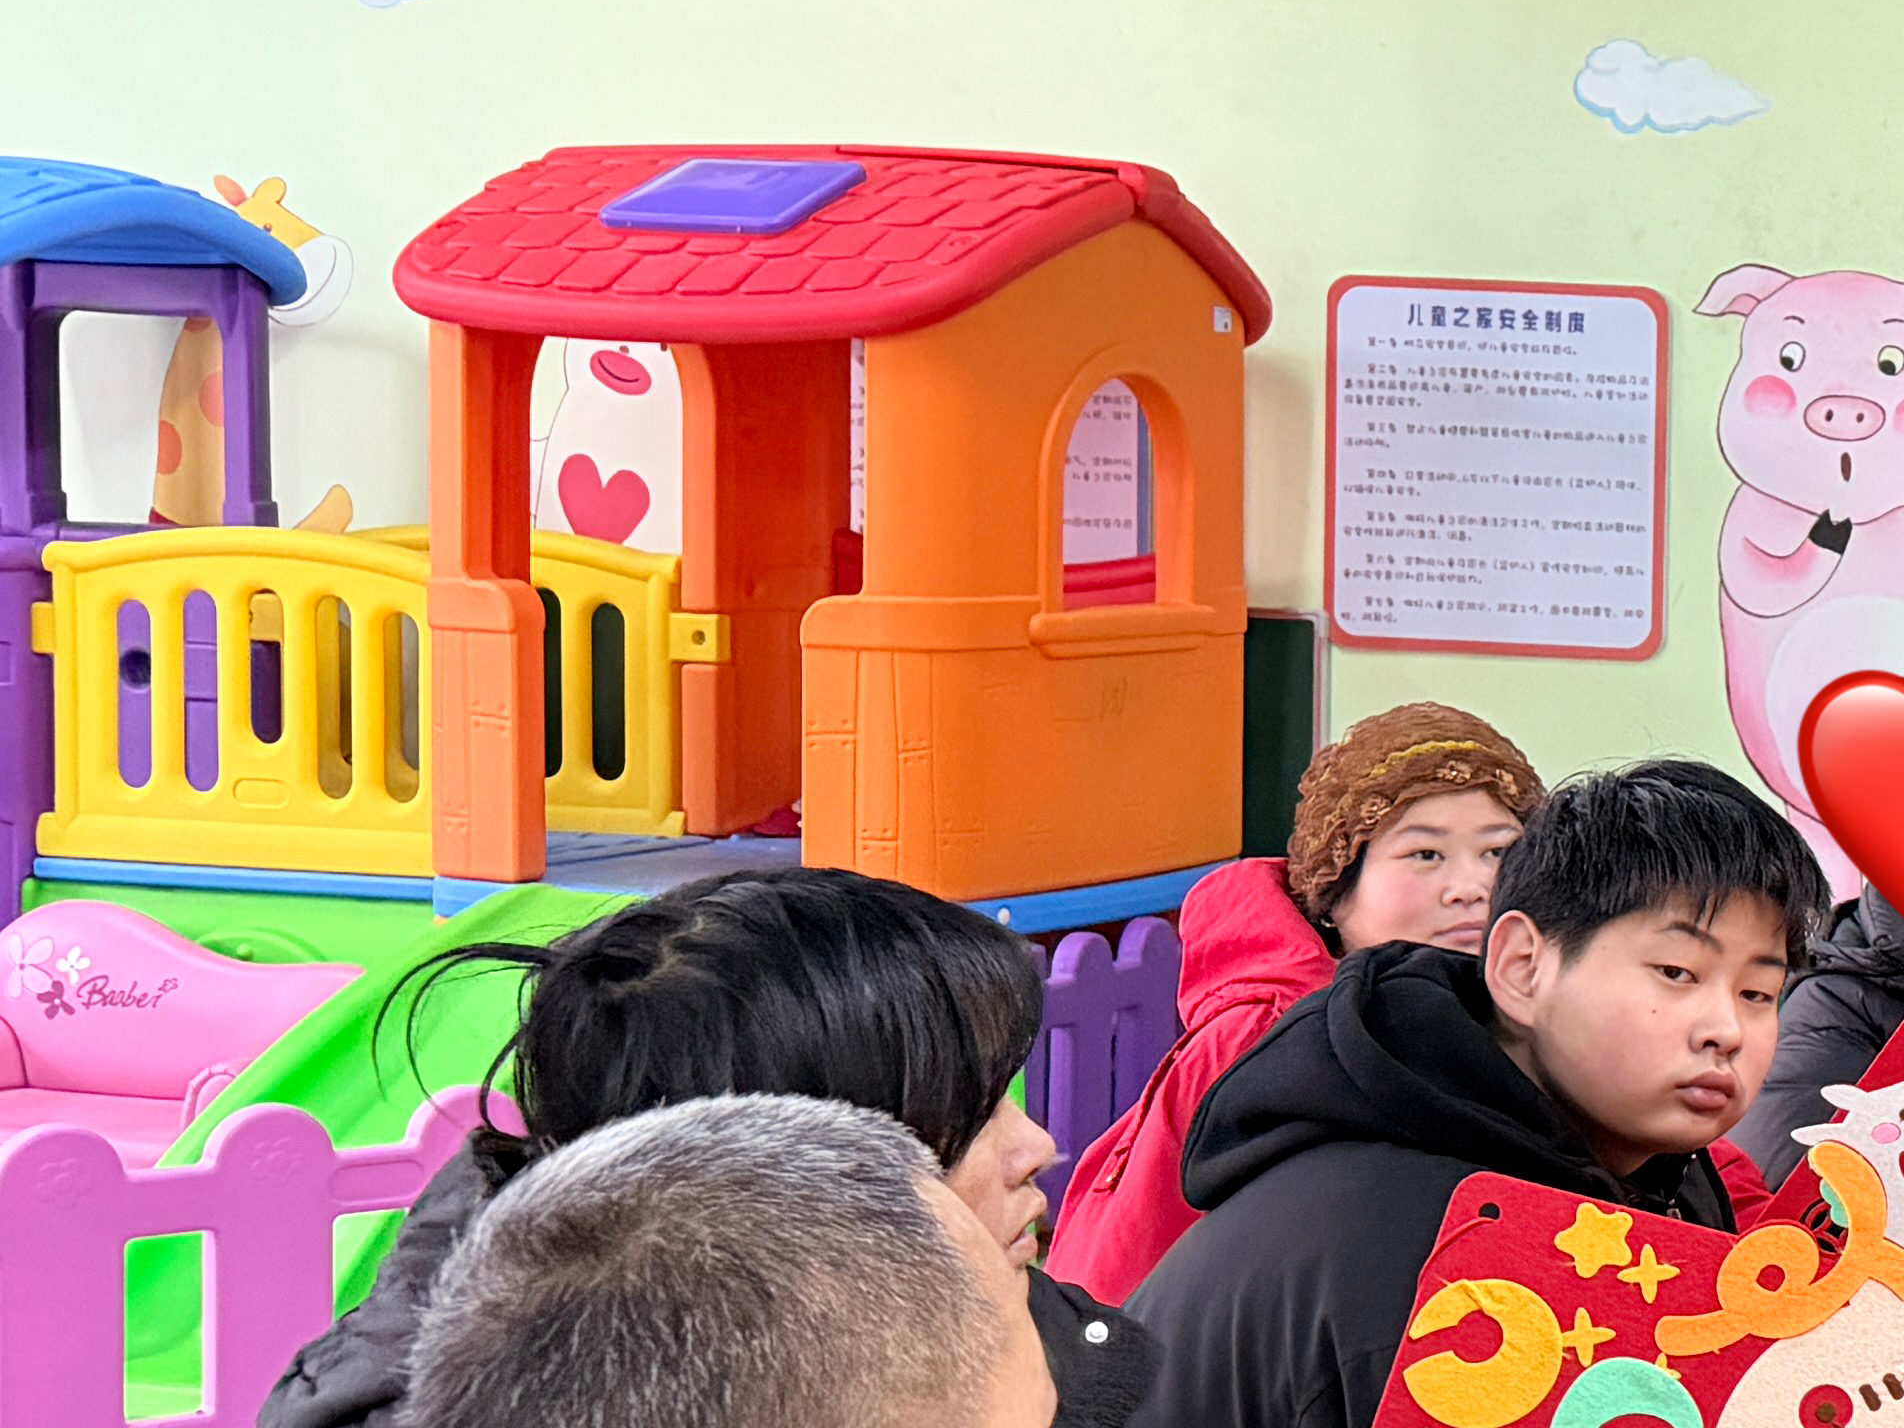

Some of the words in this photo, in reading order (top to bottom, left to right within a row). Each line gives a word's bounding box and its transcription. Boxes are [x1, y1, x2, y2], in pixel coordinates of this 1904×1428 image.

[1407, 303, 1586, 334] 儿童之家安全制度
